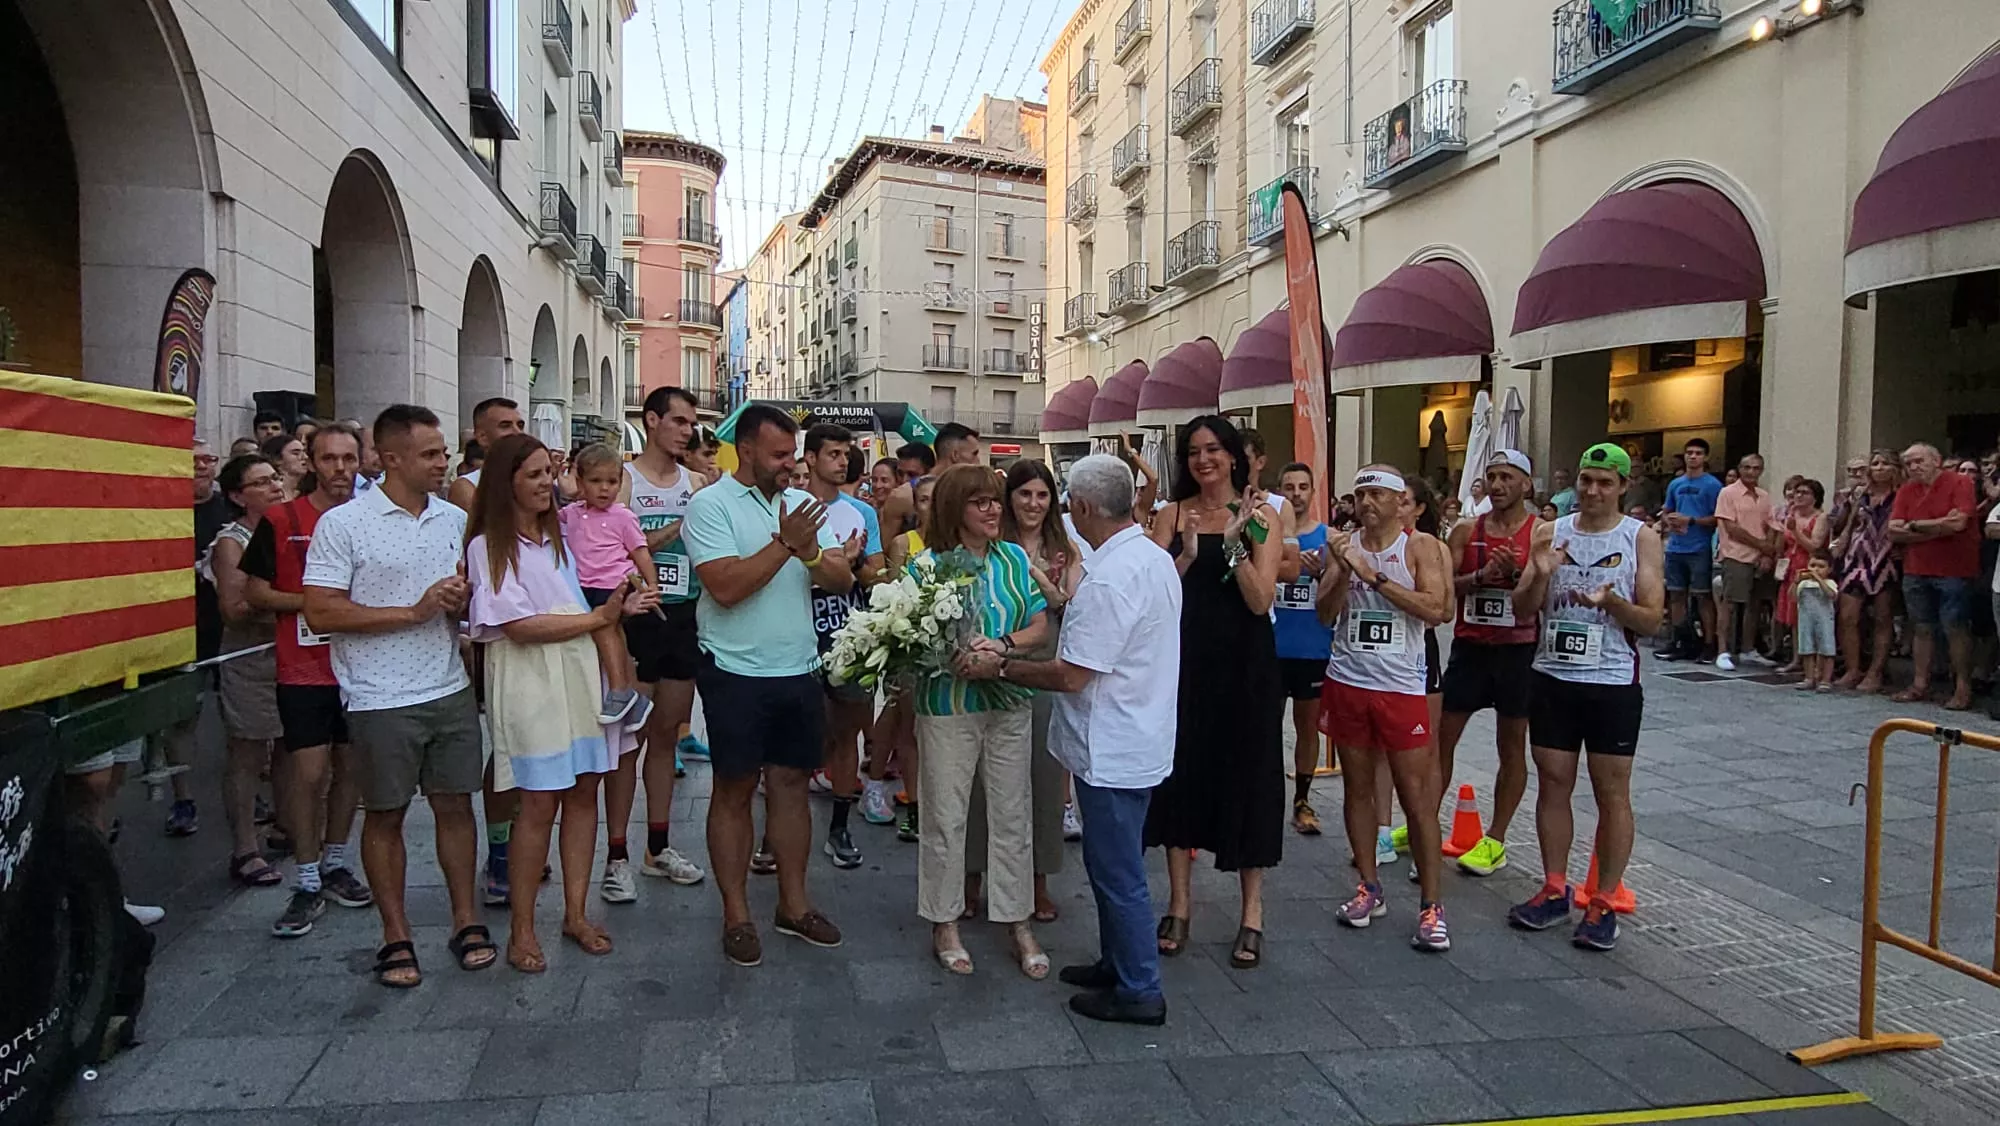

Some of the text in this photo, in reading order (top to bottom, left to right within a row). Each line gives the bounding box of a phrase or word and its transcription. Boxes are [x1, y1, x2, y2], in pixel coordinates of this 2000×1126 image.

[1030, 303, 1041, 370] HOSTAL
[814, 407, 840, 416] CAJA
[658, 567, 677, 582] 55
[1293, 588, 1309, 600] 56
[1484, 601, 1502, 615] 63
[1370, 625, 1389, 640] 61
[1565, 636, 1585, 651] 65
